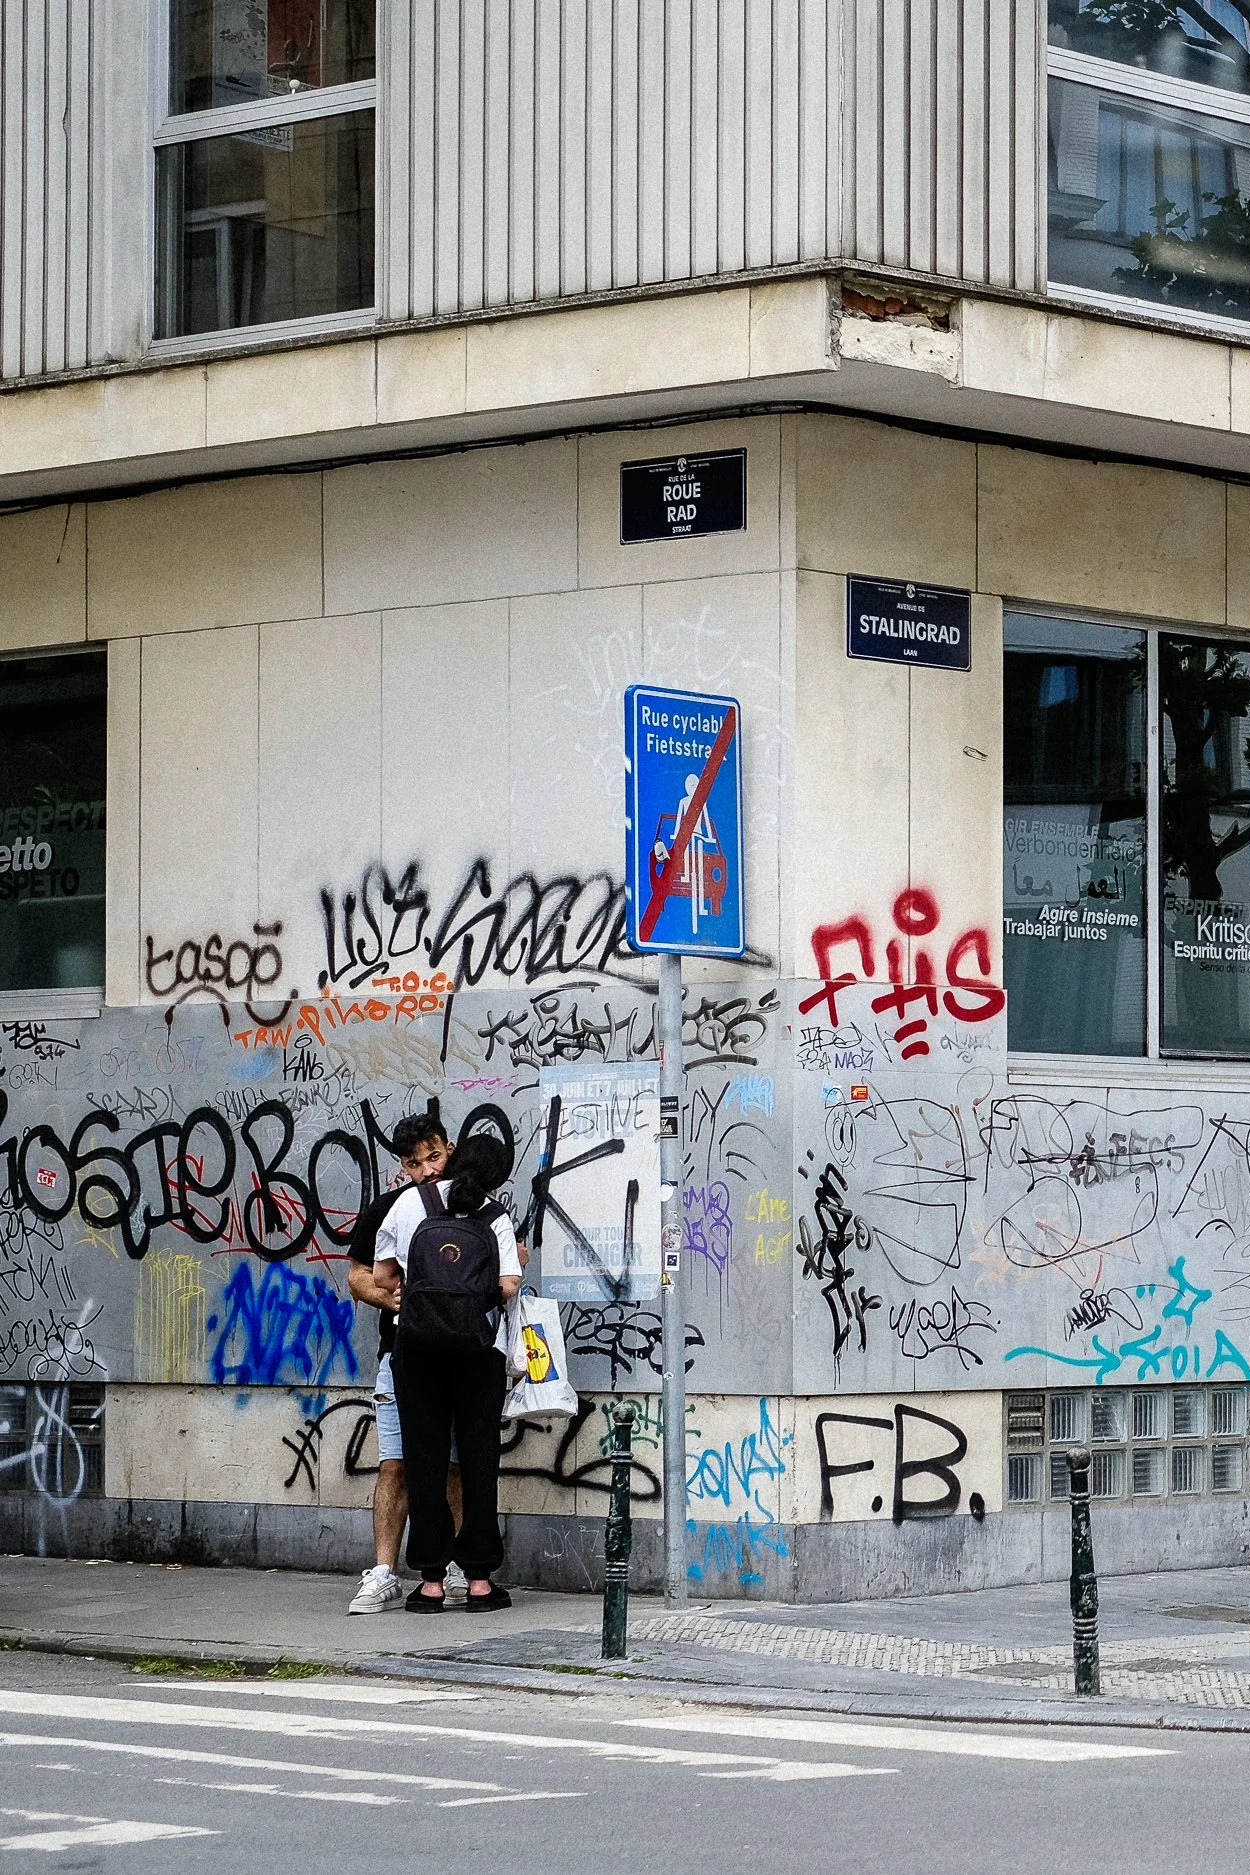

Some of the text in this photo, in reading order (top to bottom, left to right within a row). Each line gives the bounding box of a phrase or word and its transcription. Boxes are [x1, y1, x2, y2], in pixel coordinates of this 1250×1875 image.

[663, 482, 701, 501] ROUE
[667, 504, 697, 522] RAD
[860, 614, 960, 645] STALINGRAD
[641, 705, 669, 728] Rue
[1039, 905, 1138, 926] Agire insieme
[1003, 918, 1108, 941] Trabajar juntos
